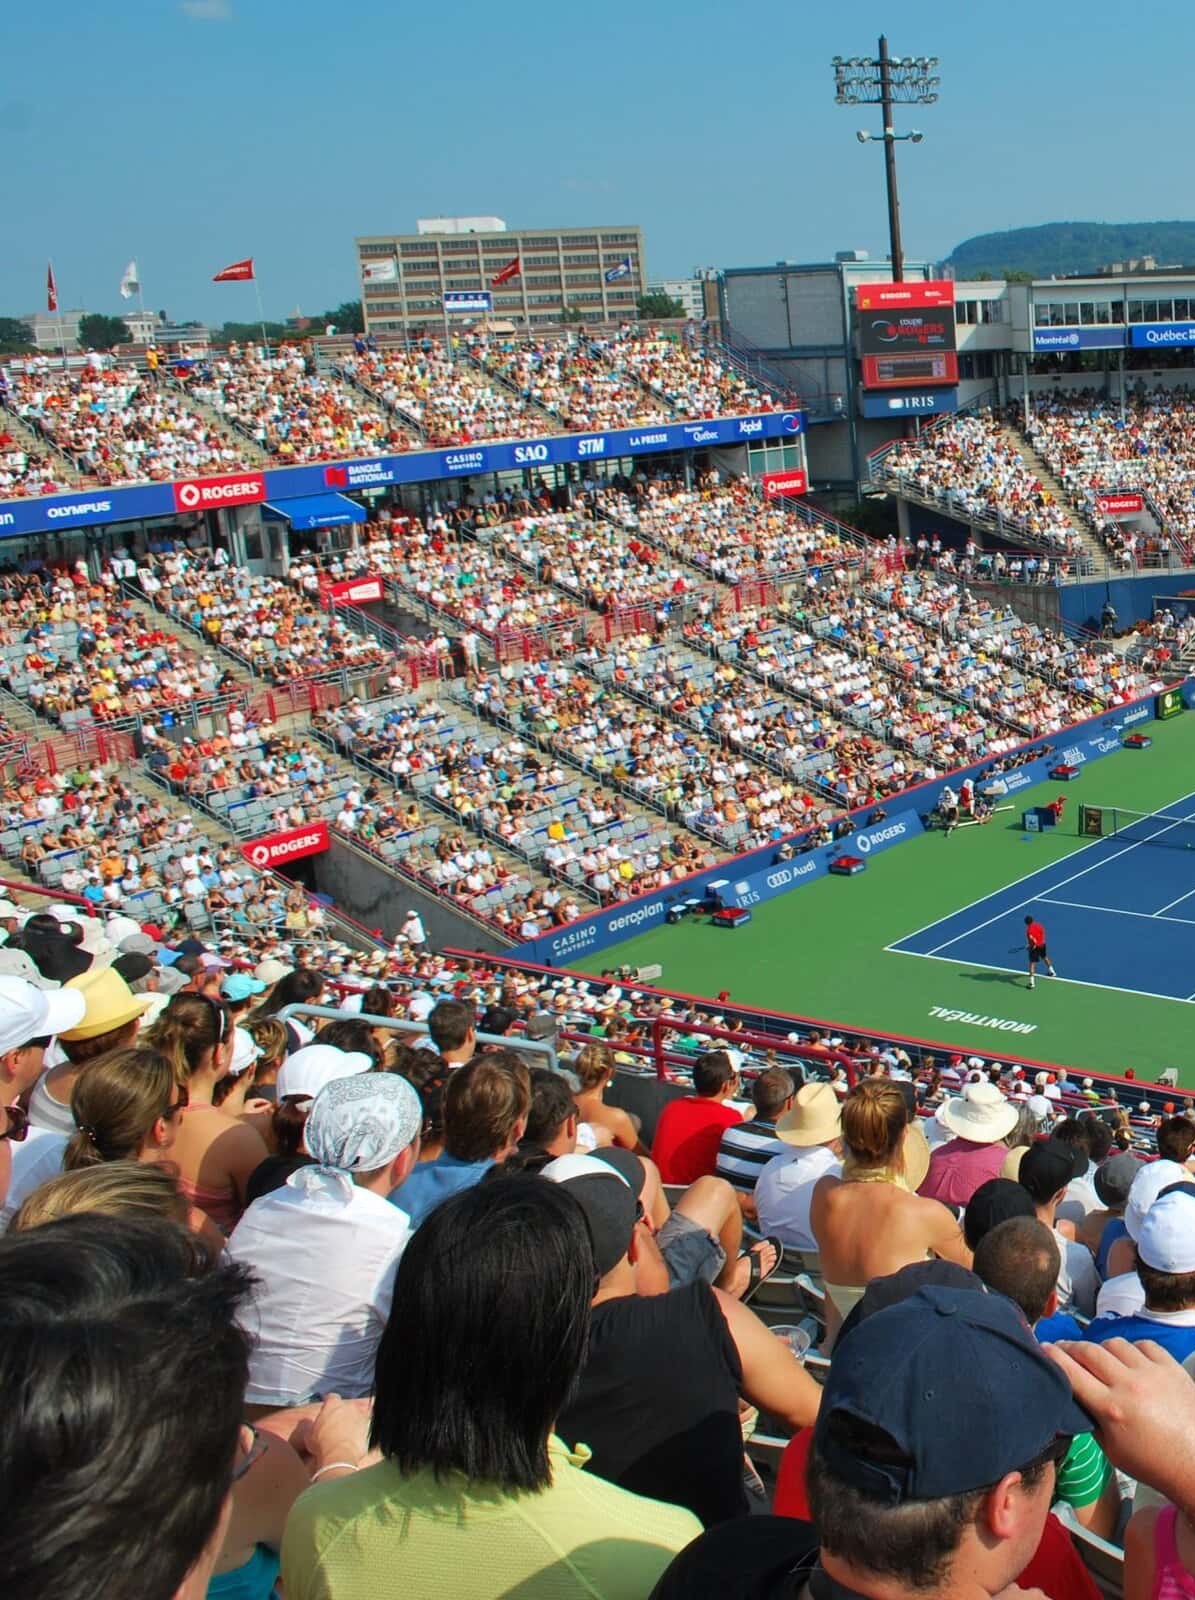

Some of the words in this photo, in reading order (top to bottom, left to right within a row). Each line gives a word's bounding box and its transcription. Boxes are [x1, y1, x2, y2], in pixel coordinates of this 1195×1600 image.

[1035, 334, 1070, 346] Montréal
[1146, 329, 1188, 343] Québec
[904, 395, 935, 409] IRIS
[578, 437, 605, 456] STM
[629, 437, 641, 447] LA
[641, 433, 668, 446] PRESSE
[445, 452, 484, 465] CASINO
[514, 444, 548, 463] SAQ
[348, 462, 382, 475] BANQUE
[349, 471, 394, 485] NATIONALE
[776, 479, 803, 491] ROGERS
[201, 482, 260, 501] ROGERS
[47, 501, 112, 519] OLYMPUS
[1109, 500, 1138, 509] ROGERS
[869, 822, 907, 845] ROGERS
[270, 833, 321, 857] ROGERS
[793, 859, 817, 878] Audi
[735, 890, 761, 908] IRIS
[607, 901, 664, 932] aeroplan
[552, 925, 597, 950] CASINO
[928, 1005, 1038, 1034] MONTRÉAL
